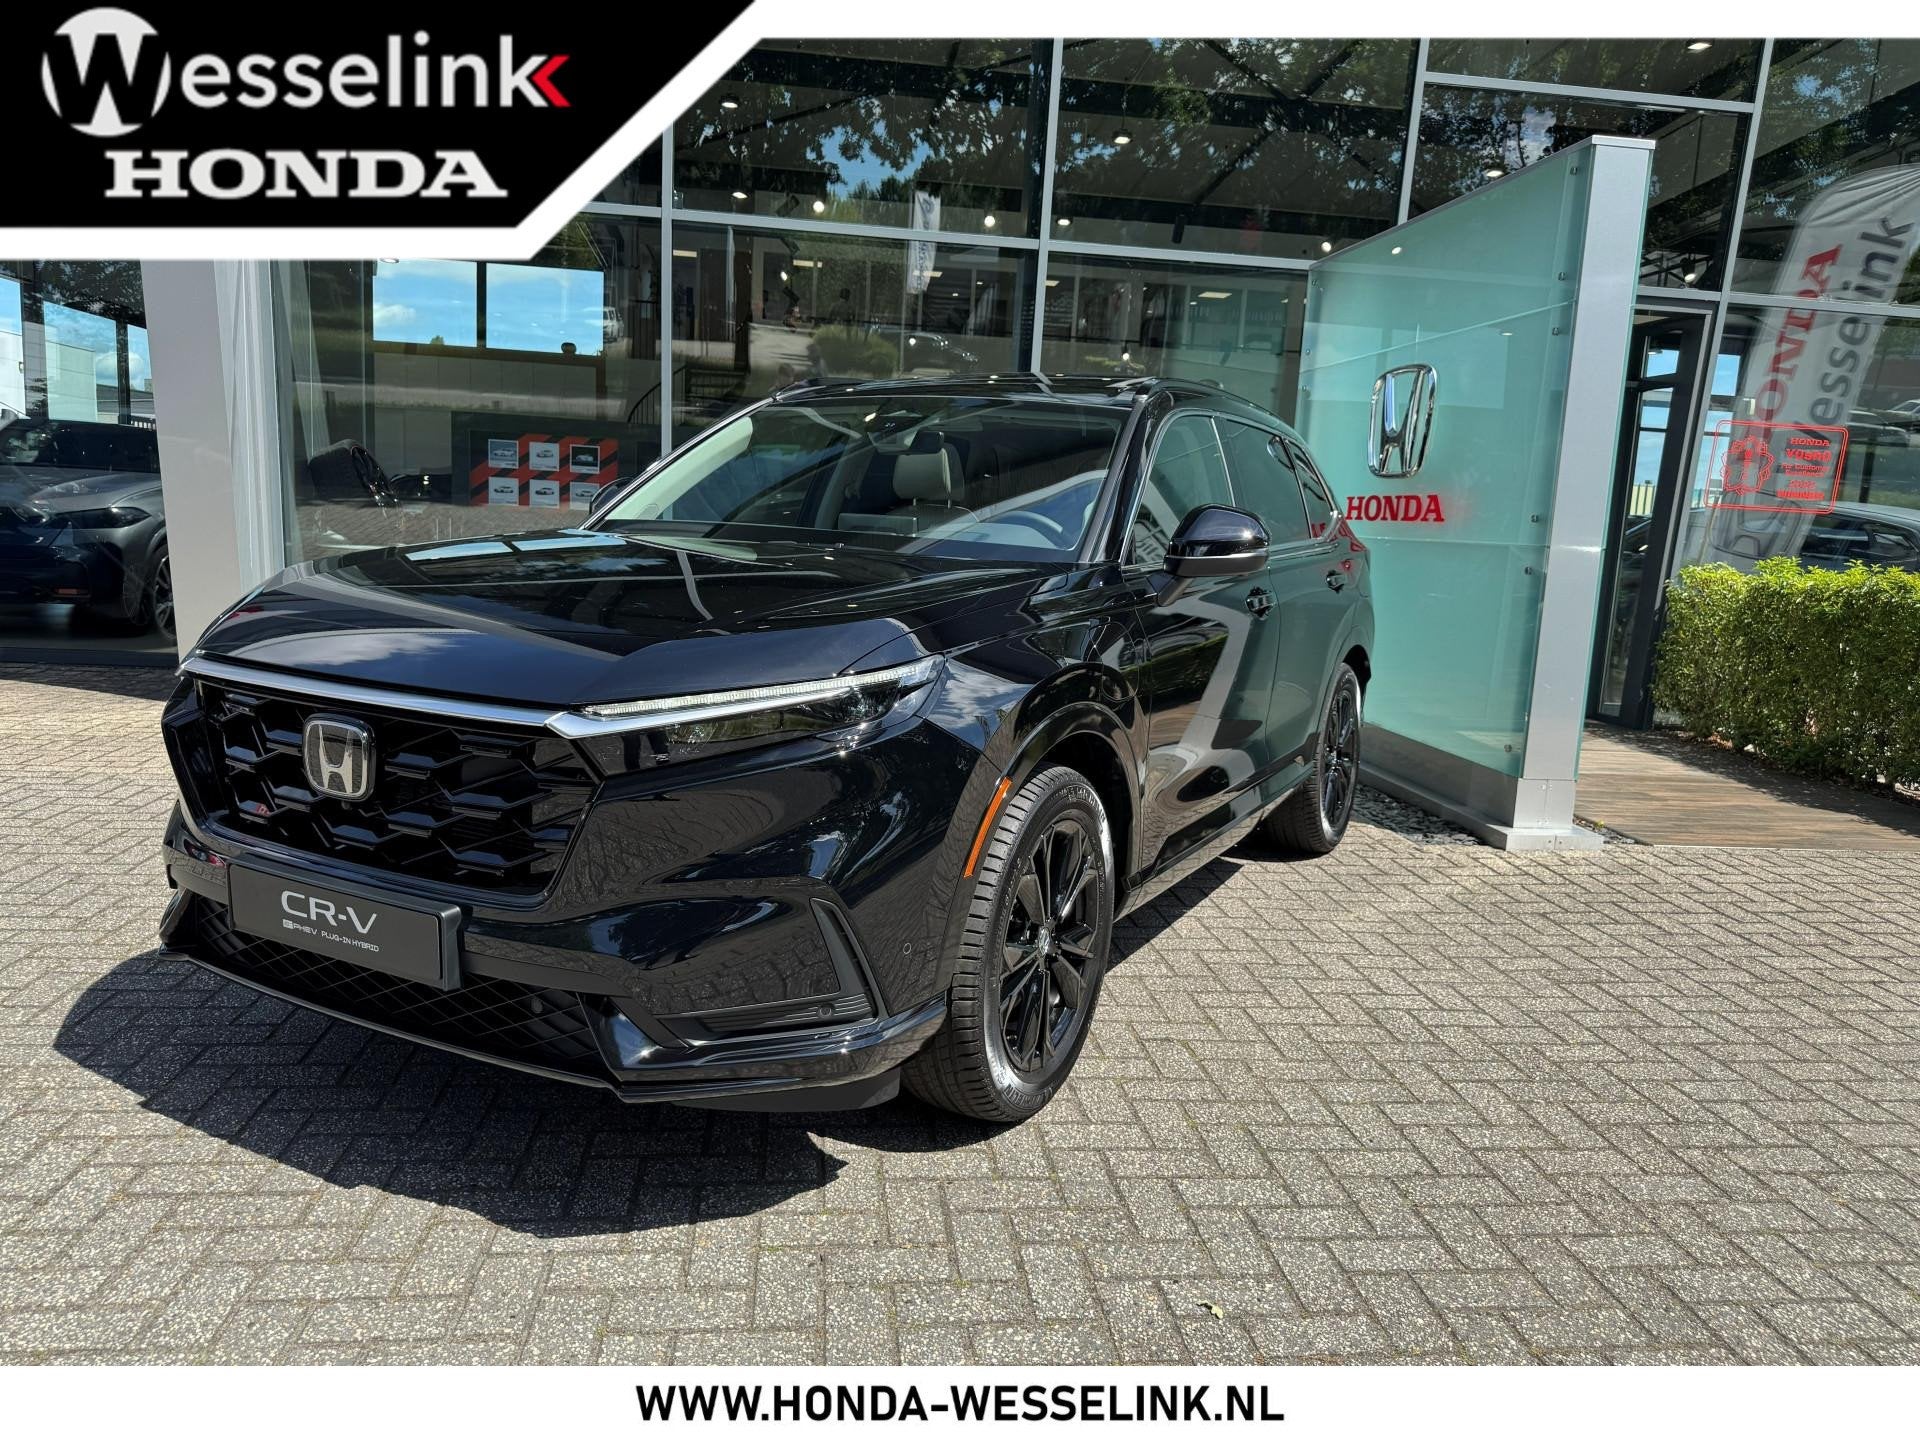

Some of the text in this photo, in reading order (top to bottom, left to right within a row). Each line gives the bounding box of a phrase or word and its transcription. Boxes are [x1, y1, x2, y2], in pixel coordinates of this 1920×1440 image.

[1789, 437, 1831, 447] HONDA
[1345, 494, 1445, 522] HONDA
[281, 890, 378, 934] CR-V
[321, 930, 352, 945] PLUG-IN
[352, 939, 380, 952] HYBRID
